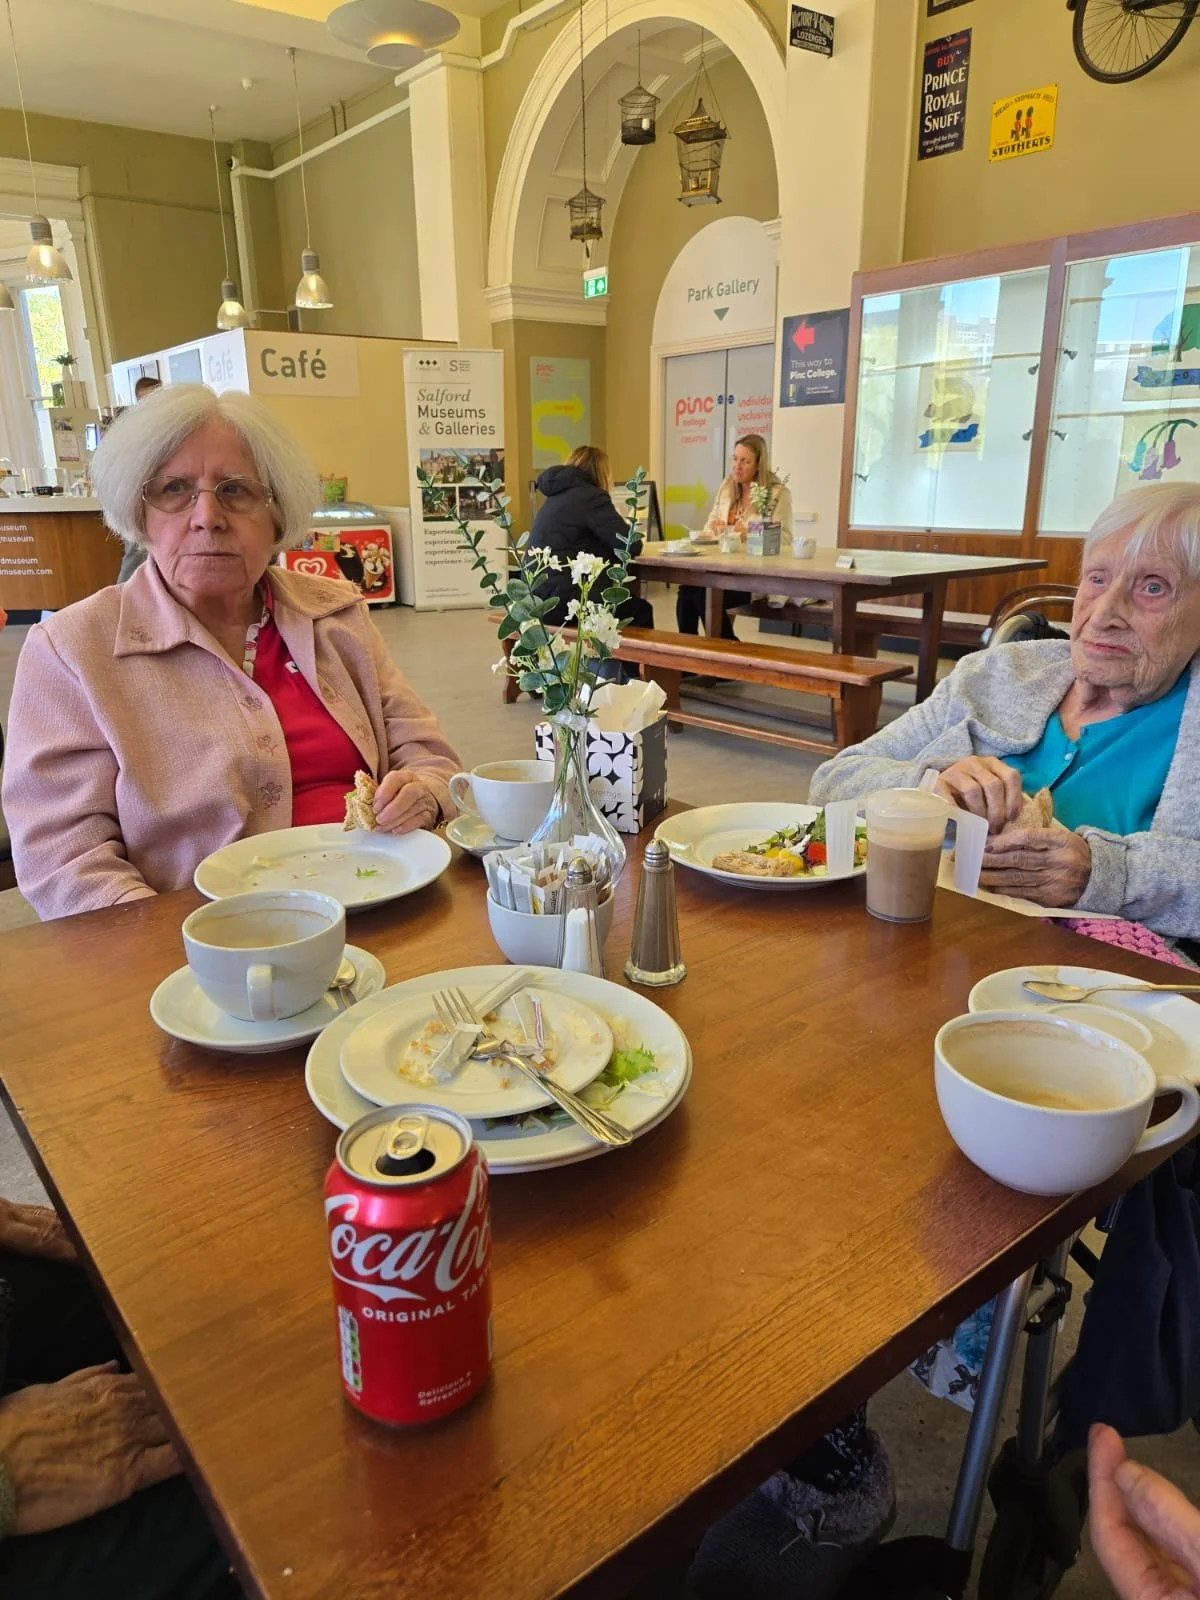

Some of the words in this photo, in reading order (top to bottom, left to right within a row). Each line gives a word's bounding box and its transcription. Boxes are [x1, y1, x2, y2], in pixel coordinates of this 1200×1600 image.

[936, 53, 957, 68] BUY
[923, 66, 967, 94] PRINCE
[924, 89, 963, 114] ROYAL
[923, 110, 961, 133] SNUFF
[991, 135, 1052, 158] STOTHERTS
[687, 284, 714, 303] Park
[716, 278, 761, 297] Gallery
[207, 347, 235, 382] Café
[260, 348, 328, 379] Café
[791, 360, 808, 369] This
[808, 360, 823, 368] way
[823, 358, 833, 366] to
[417, 388, 471, 406] Salford
[417, 404, 487, 419] Museums
[675, 396, 715, 426] pinc
[418, 421, 431, 436] &
[434, 421, 496, 436] Galleries
[0, 535, 35, 544] museum
[361, 1300, 456, 1323] ORIGINAL
